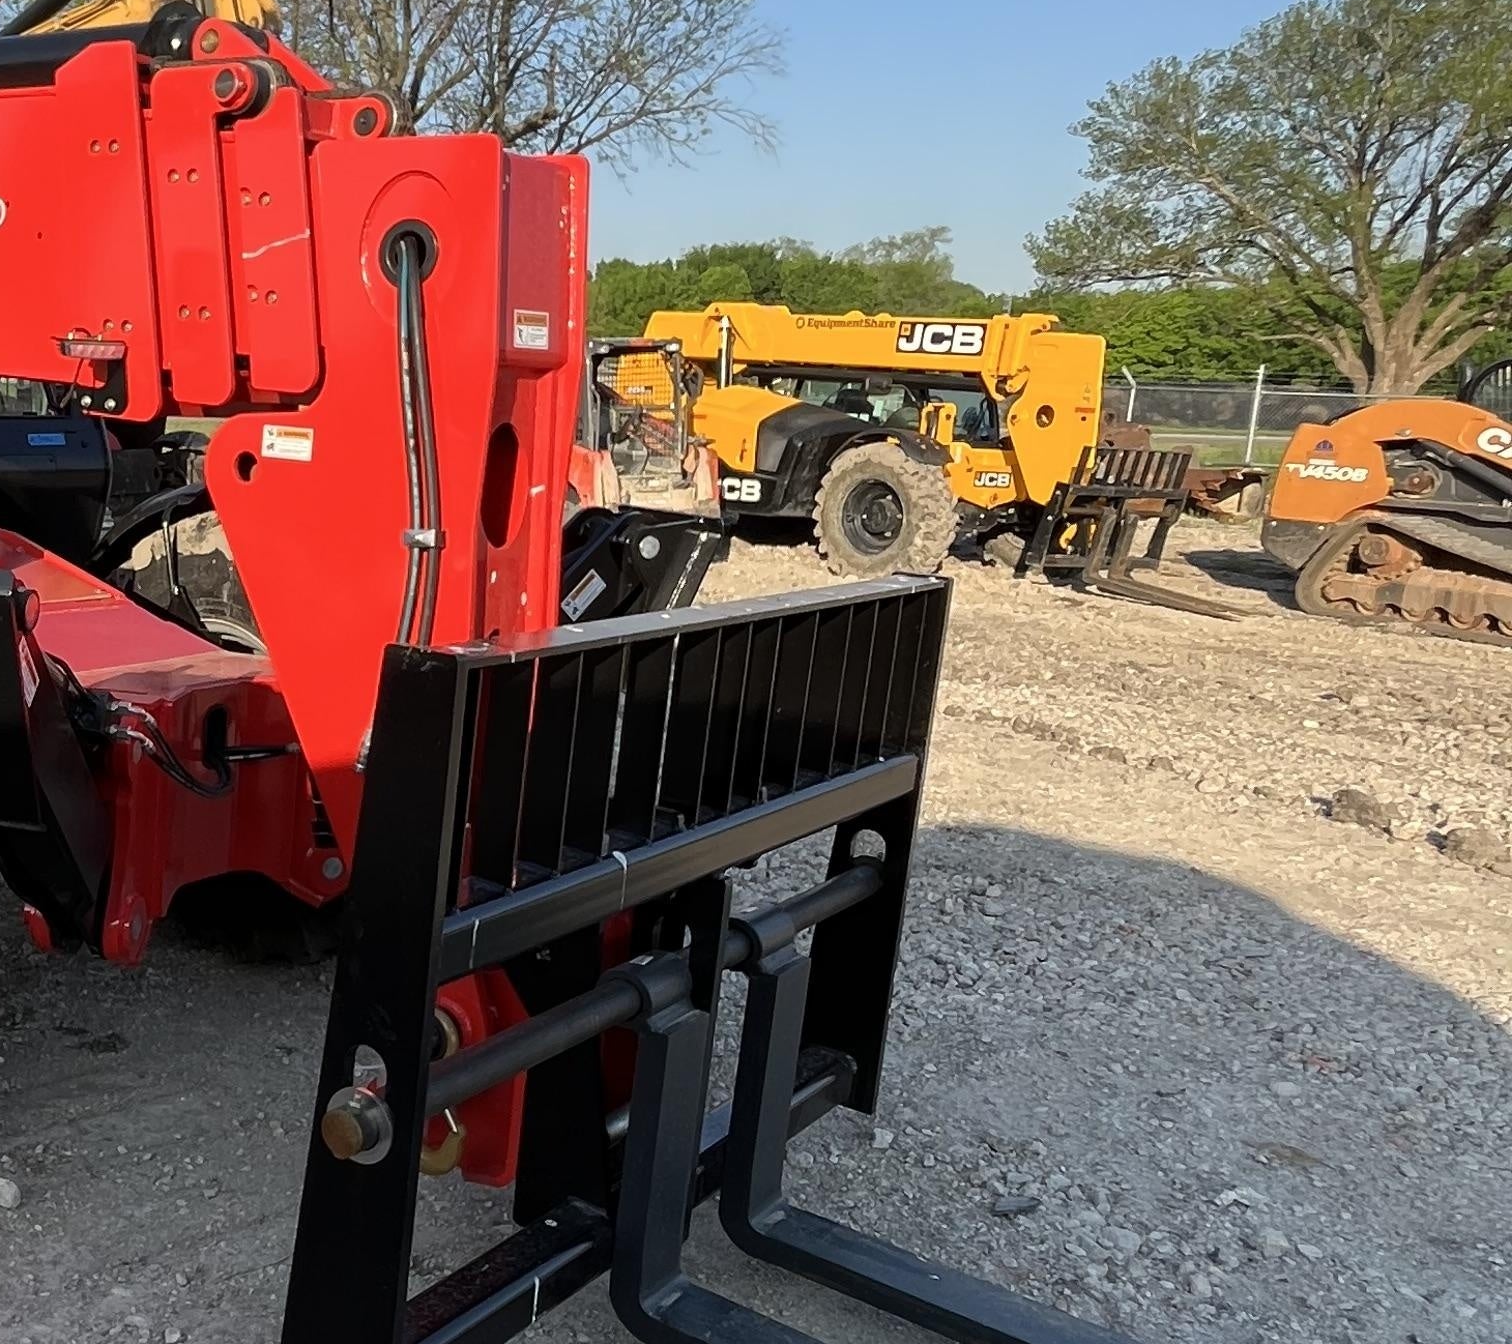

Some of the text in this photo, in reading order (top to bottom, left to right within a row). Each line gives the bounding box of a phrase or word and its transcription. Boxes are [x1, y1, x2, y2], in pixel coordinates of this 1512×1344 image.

[807, 317, 896, 330] EquipmentShare
[897, 322, 985, 355] JCB
[1477, 426, 1512, 459] C
[974, 471, 1011, 487] JCB
[1285, 463, 1369, 482] TV450B
[717, 477, 762, 503] CB
